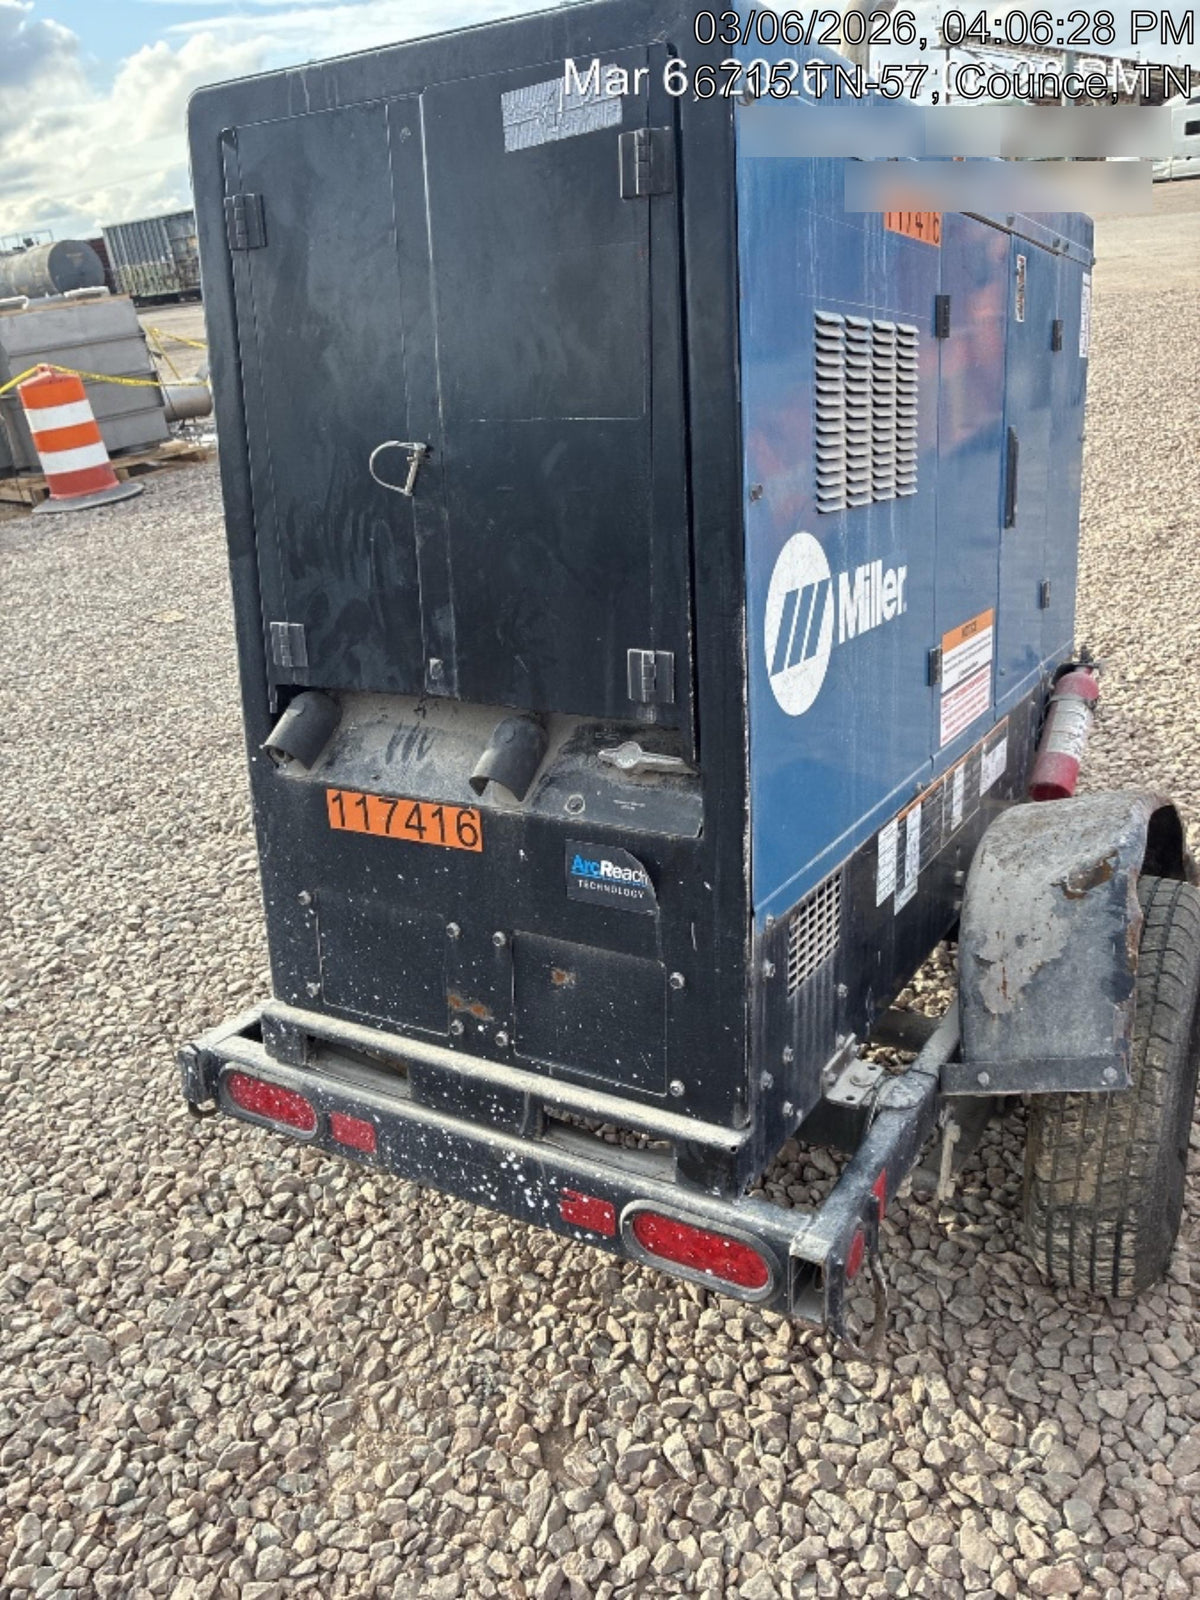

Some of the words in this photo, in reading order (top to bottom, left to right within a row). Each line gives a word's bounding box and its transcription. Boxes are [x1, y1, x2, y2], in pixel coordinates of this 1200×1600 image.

[838, 559, 908, 645] Miller
[331, 790, 480, 847] 117416
[571, 853, 650, 886] ArcReach
[577, 879, 645, 899] TECHNOLOGY
